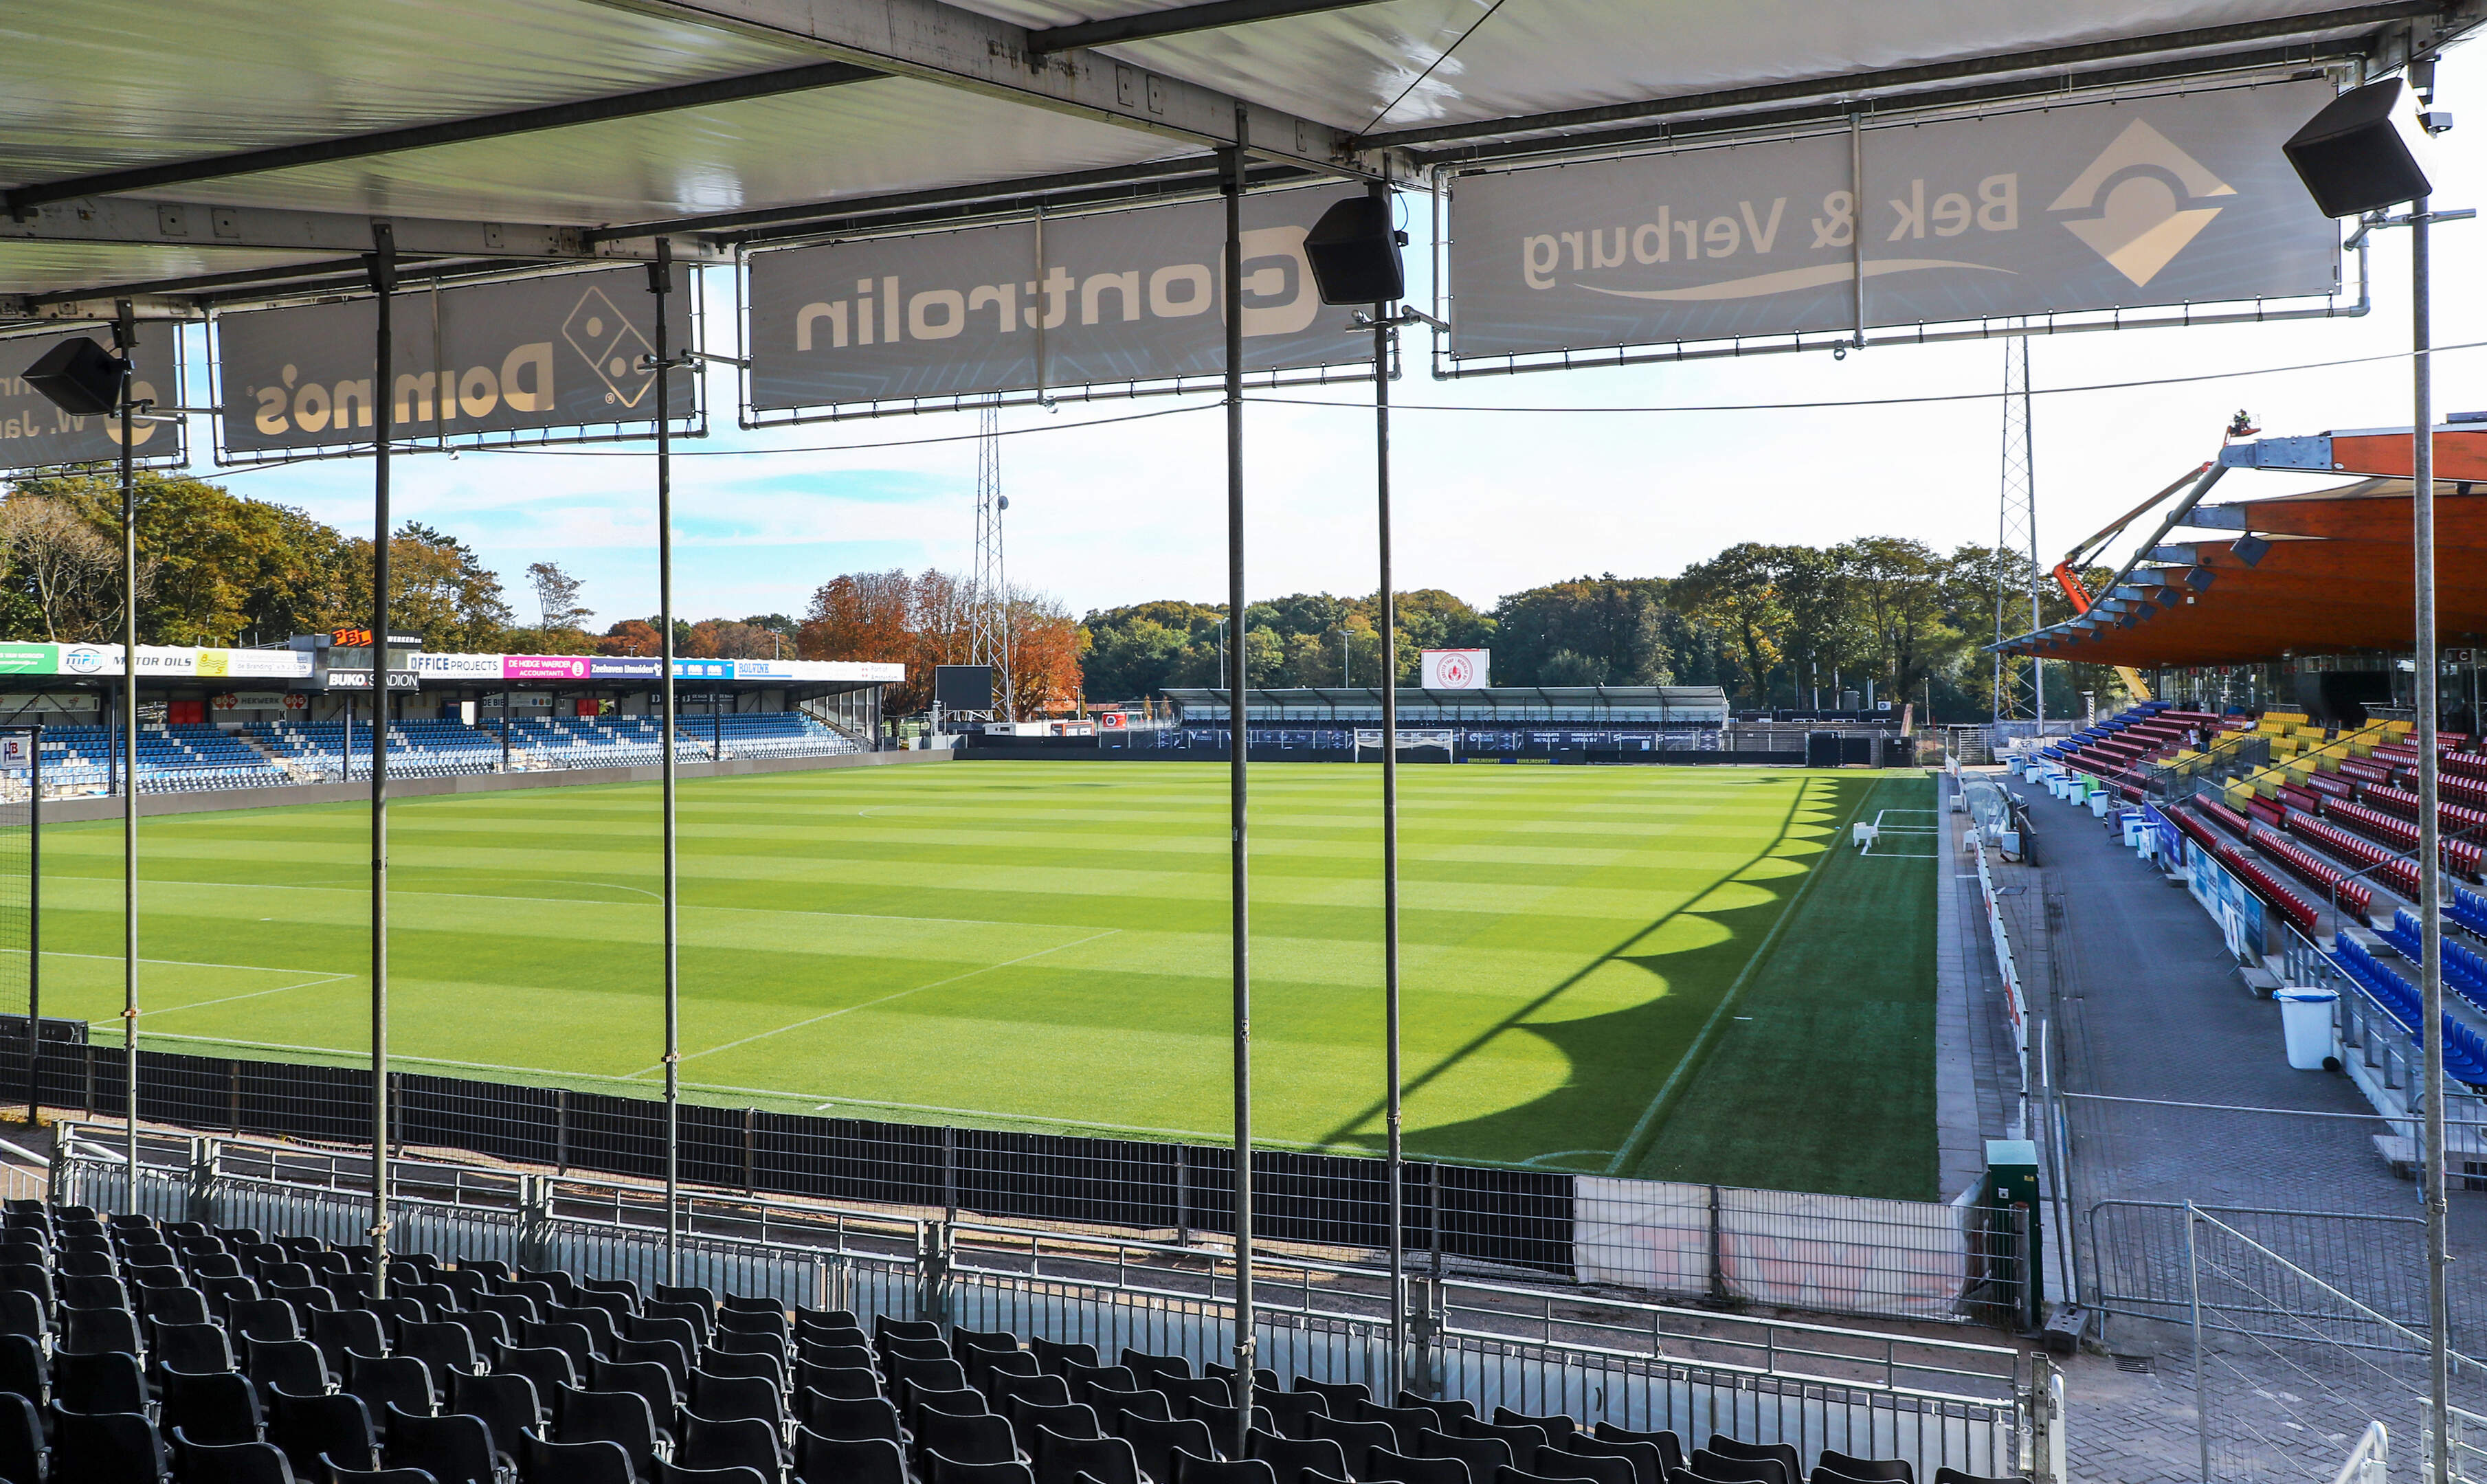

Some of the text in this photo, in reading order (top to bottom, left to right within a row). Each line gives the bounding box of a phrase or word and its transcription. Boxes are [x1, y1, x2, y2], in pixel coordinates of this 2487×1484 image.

[113, 656, 192, 666] MTOR OILS
[2459, 651, 2468, 661] C
[411, 657, 498, 671] OFFICE PROJECTS
[508, 660, 519, 668] DE
[591, 664, 620, 673] Zeehaven
[368, 673, 419, 687] SDION
[241, 697, 280, 705] HEKWERK
[279, 710, 285, 721] K
